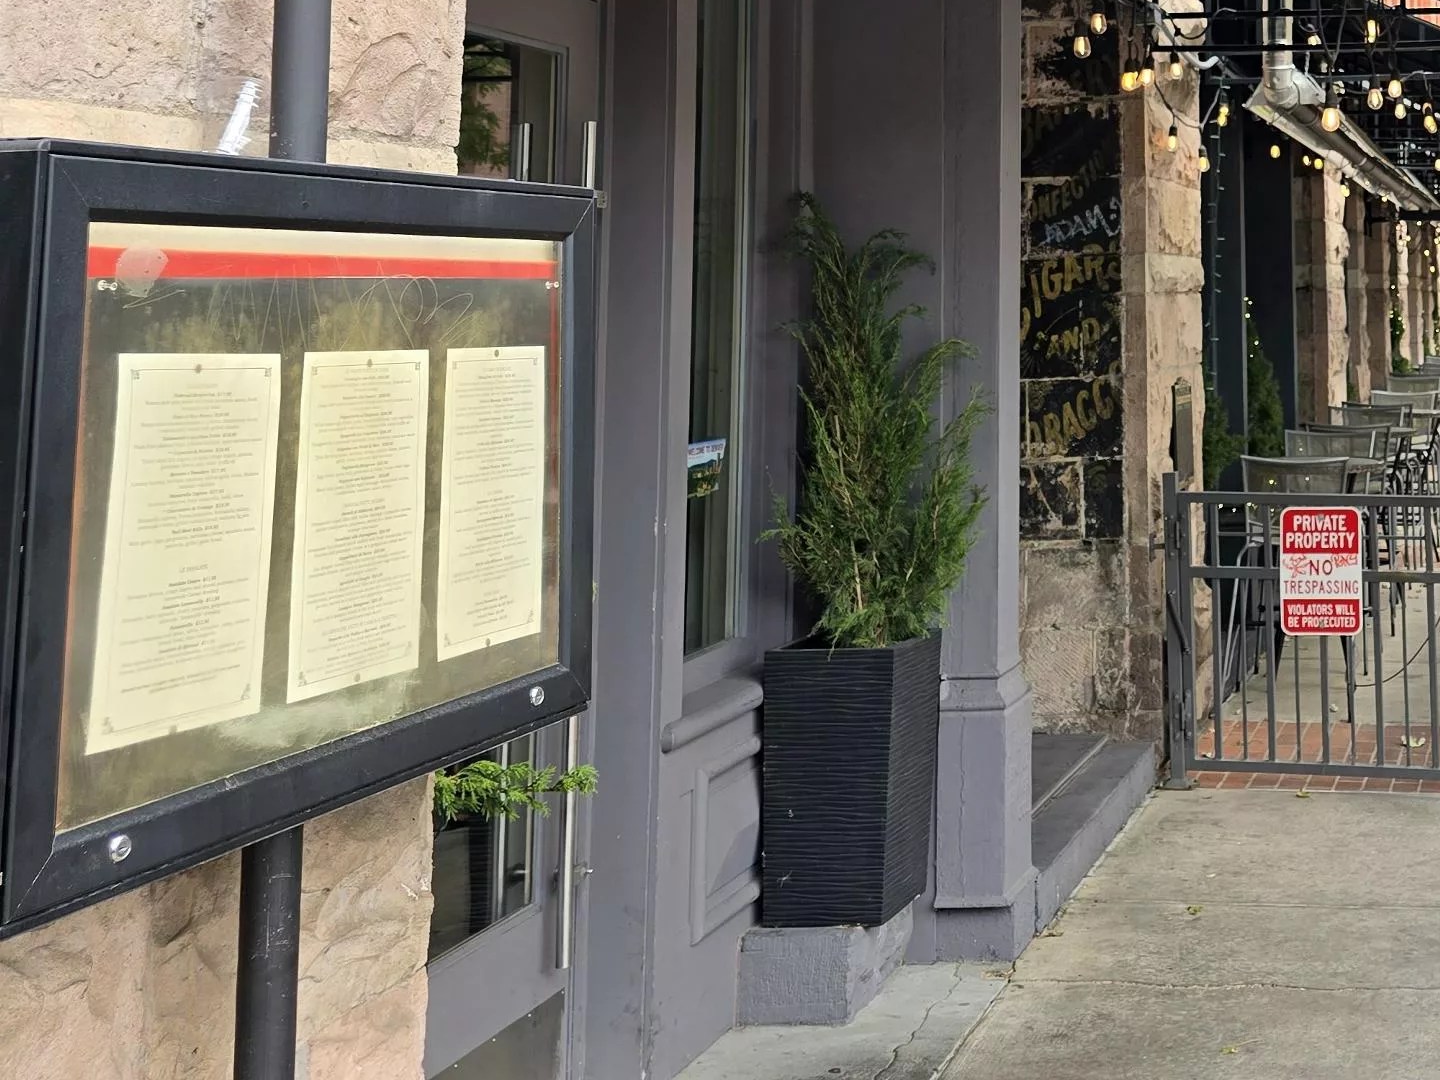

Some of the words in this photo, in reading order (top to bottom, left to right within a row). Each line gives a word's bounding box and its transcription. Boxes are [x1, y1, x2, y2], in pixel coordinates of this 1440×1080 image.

[1293, 514, 1347, 532] PRIVATE
[1286, 532, 1356, 549] PROPERTY
[1309, 559, 1334, 576] NO
[1284, 580, 1359, 595] TRESPASSING
[1288, 604, 1333, 616] VIOLATORS
[1335, 604, 1356, 616] WILL
[1288, 616, 1300, 628] BE
[1301, 616, 1356, 628] PROSECUTED
